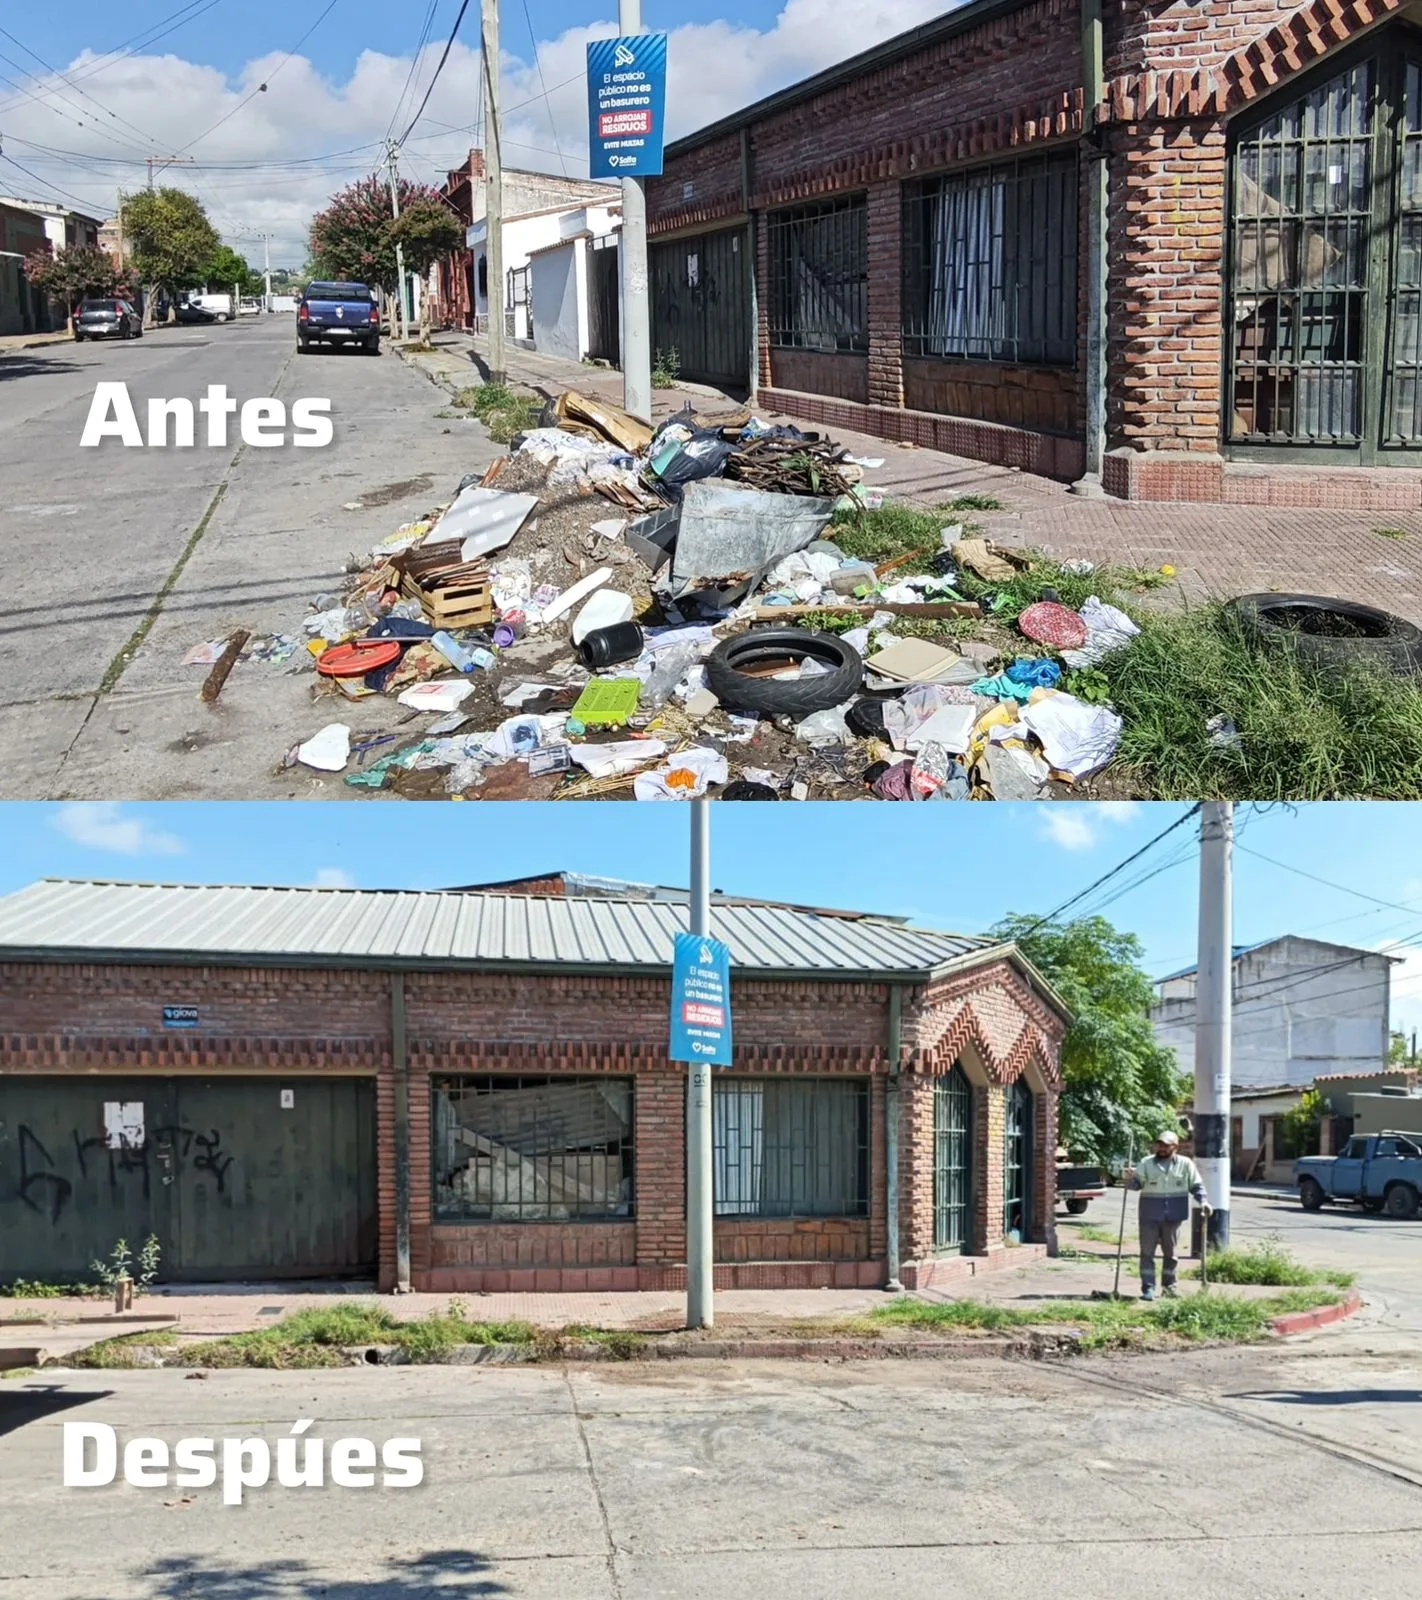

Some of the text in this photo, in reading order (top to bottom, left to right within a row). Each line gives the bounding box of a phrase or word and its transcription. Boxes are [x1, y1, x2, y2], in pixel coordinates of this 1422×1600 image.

[603, 71, 645, 83] El espacio
[598, 83, 651, 98] público no es
[600, 96, 649, 109] un basurero
[602, 113, 647, 125] NO ARROJAR
[602, 121, 647, 134] RESIDUOS
[604, 141, 619, 149] EVITE
[685, 990, 695, 998] un
